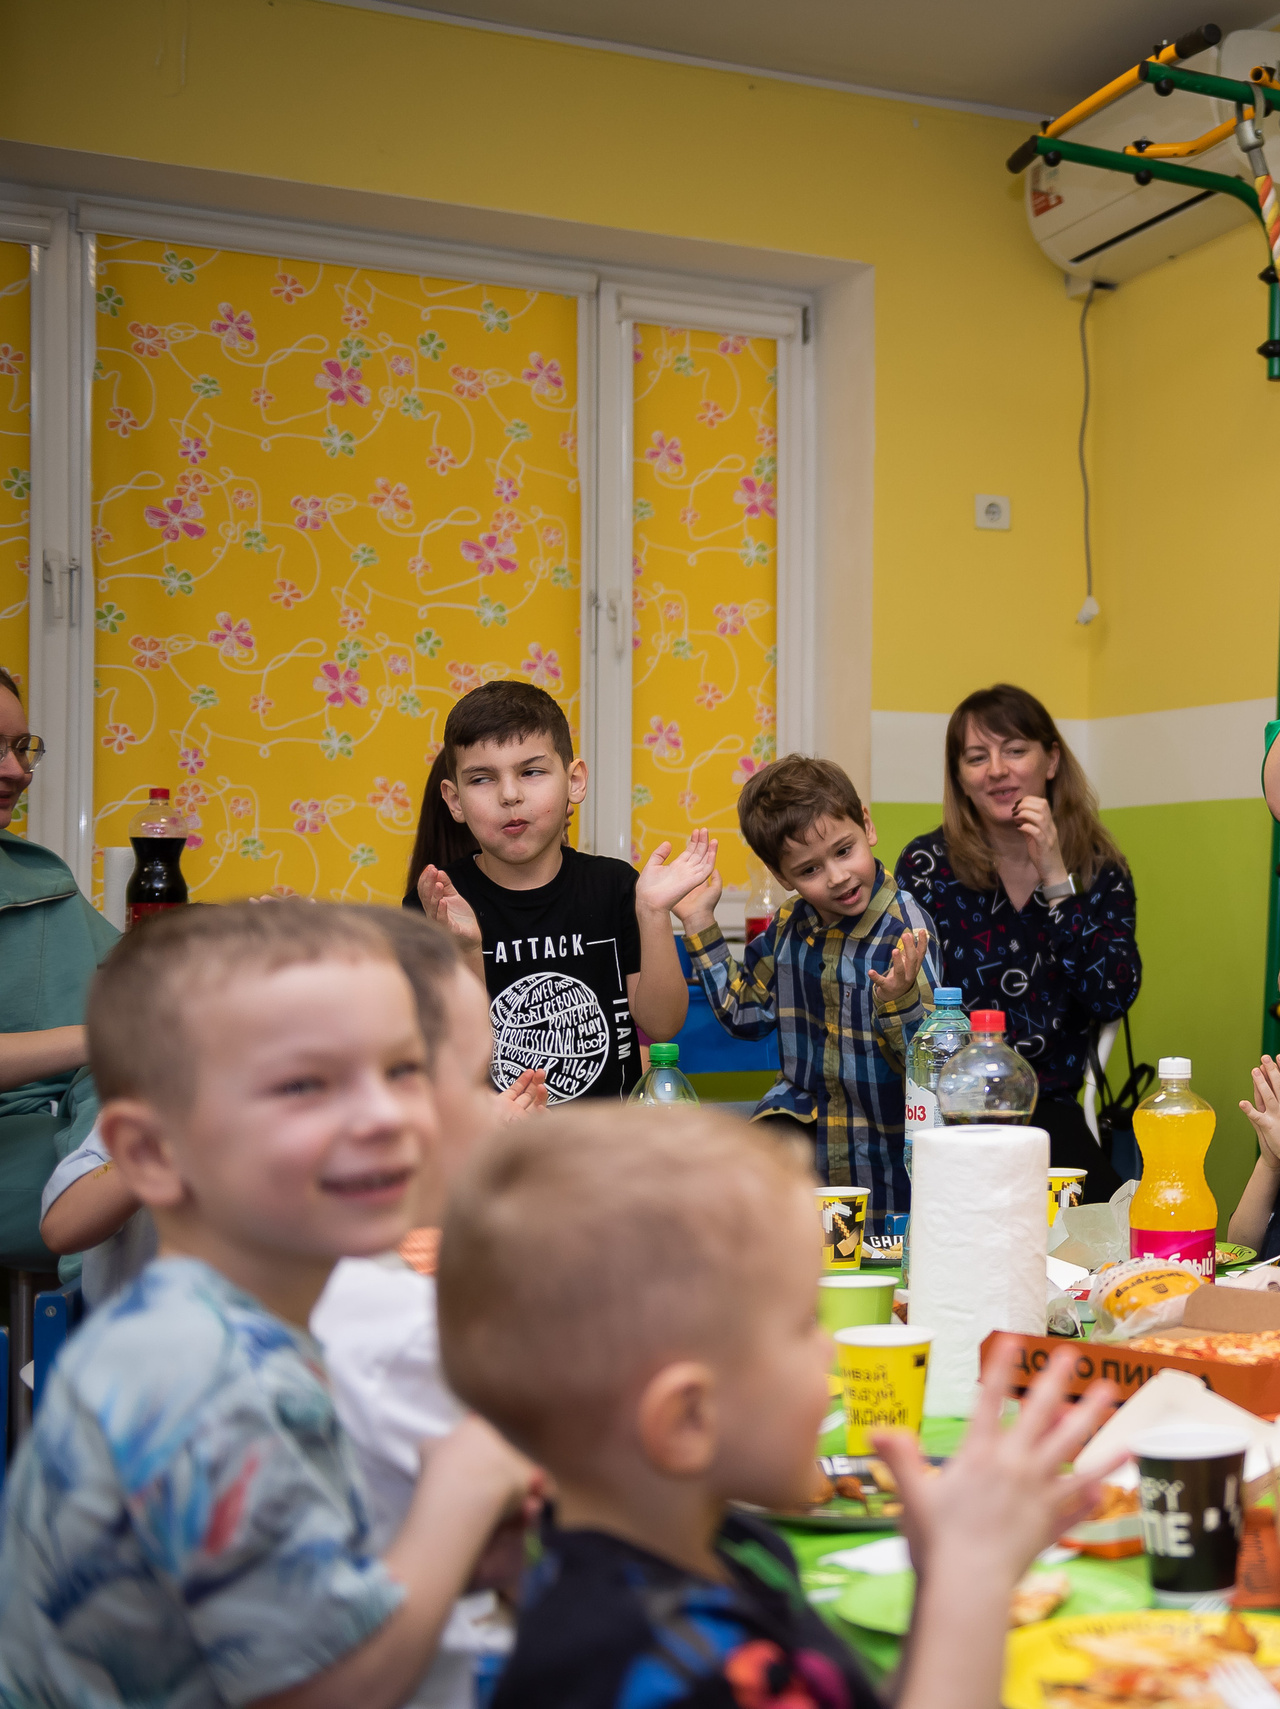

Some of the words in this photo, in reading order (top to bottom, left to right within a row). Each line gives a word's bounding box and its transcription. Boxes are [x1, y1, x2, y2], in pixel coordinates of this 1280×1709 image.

[495, 933, 584, 963] ATTACK
[517, 979, 554, 1011] PLAYER
[554, 978, 574, 992] PASS
[509, 1003, 543, 1025] SPORT
[544, 985, 595, 1021] REBOUND
[549, 1003, 601, 1030] POWERFUL
[578, 1016, 603, 1039] PLAY
[503, 1027, 577, 1055] PROFESSIONAL
[577, 1032, 606, 1053] HOOP
[500, 1044, 560, 1079] CROSSOVER
[502, 1063, 522, 1077] SPEED
[561, 1057, 600, 1083] HIGH
[549, 1072, 580, 1095] LUCK
